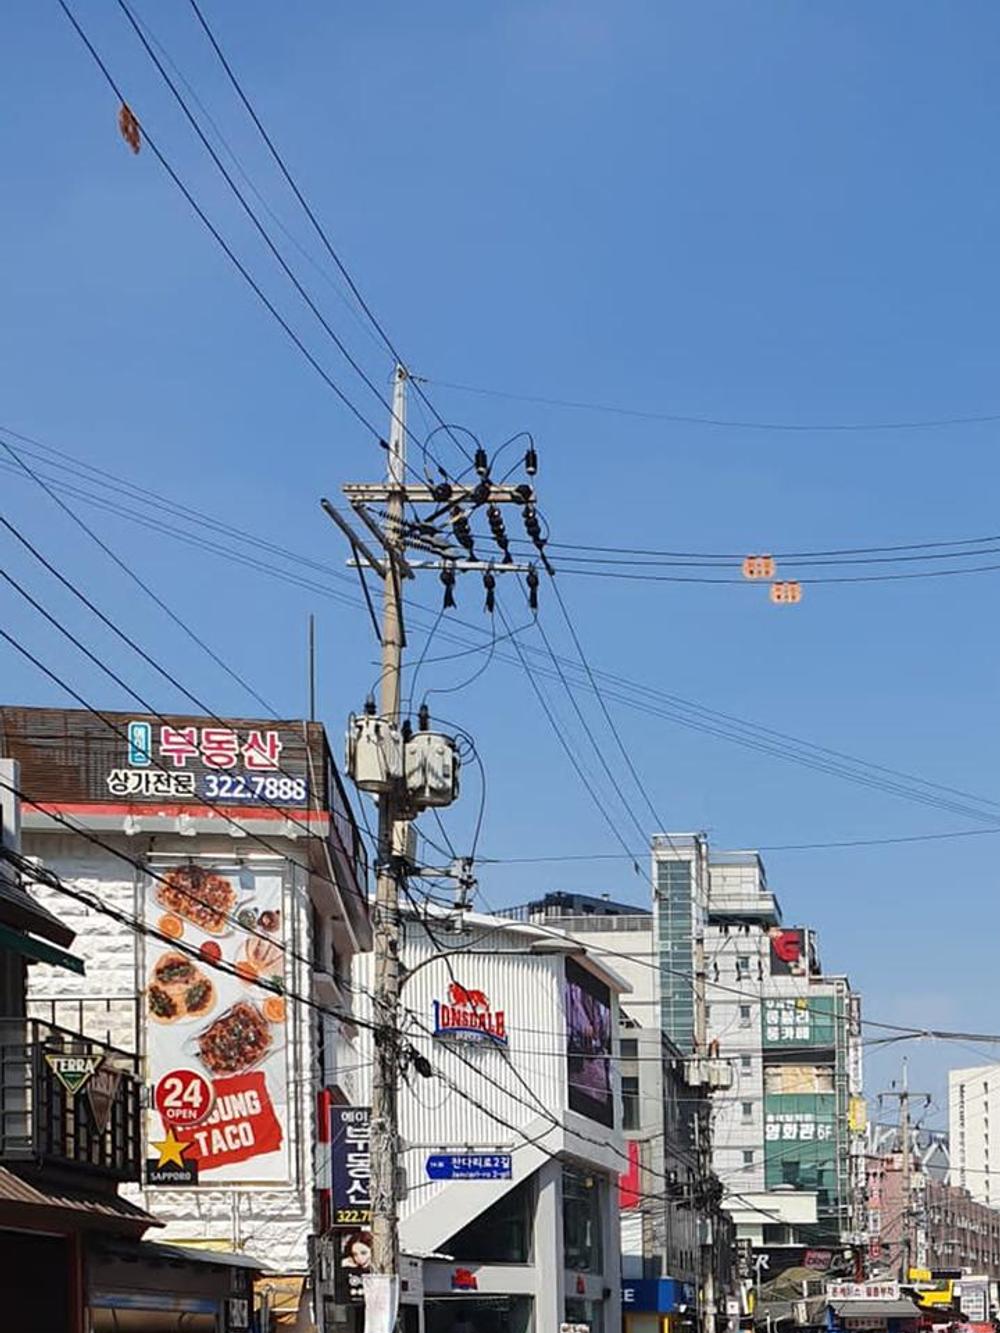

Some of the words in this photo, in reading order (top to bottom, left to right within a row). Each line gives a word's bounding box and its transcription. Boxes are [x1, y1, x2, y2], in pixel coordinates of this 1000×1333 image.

[160, 726, 282, 770] 부동산
[107, 770, 195, 796] 상가전문
[204, 775, 307, 800] 322.7888
[433, 999, 509, 1046] LONSDALE
[52, 1057, 95, 1075] TERRA
[163, 1078, 202, 1108] 24
[166, 1109, 198, 1120] OPEN
[341, 1110, 368, 1123] 에이
[194, 1121, 255, 1157] TACO
[150, 1172, 192, 1182] SAPPORO
